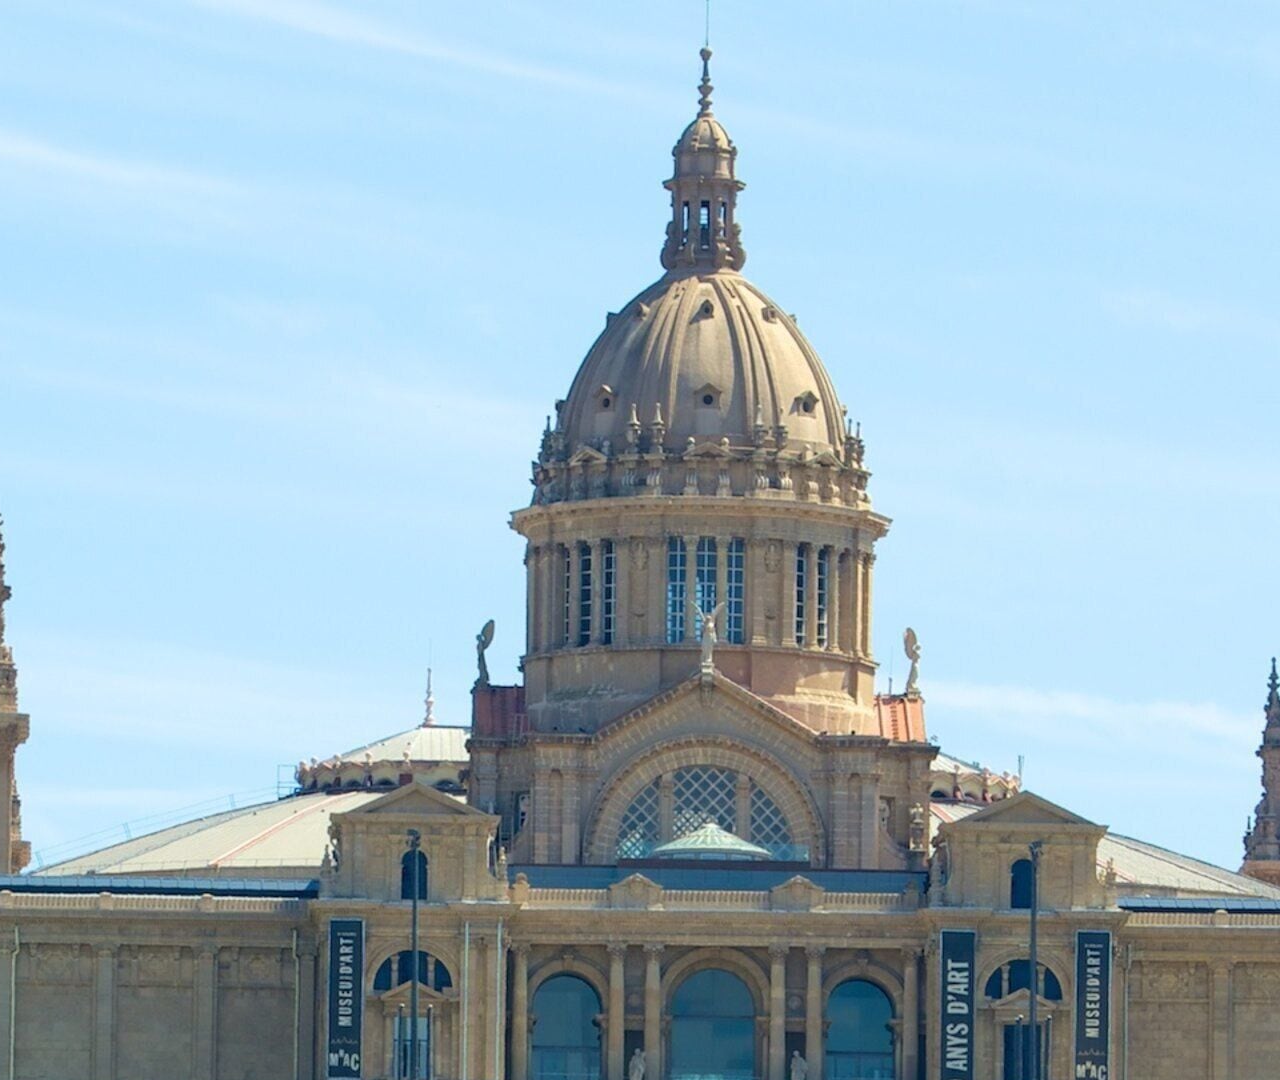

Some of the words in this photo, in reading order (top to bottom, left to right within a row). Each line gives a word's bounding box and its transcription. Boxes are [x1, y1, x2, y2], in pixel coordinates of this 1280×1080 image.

[339, 937, 354, 974] D'ART
[1086, 949, 1100, 986] D'ART
[338, 980, 353, 1027] MUSEU
[947, 958, 969, 1014] D'ART
[1085, 992, 1100, 1038] MUSEU
[946, 1023, 969, 1071] ANYS
